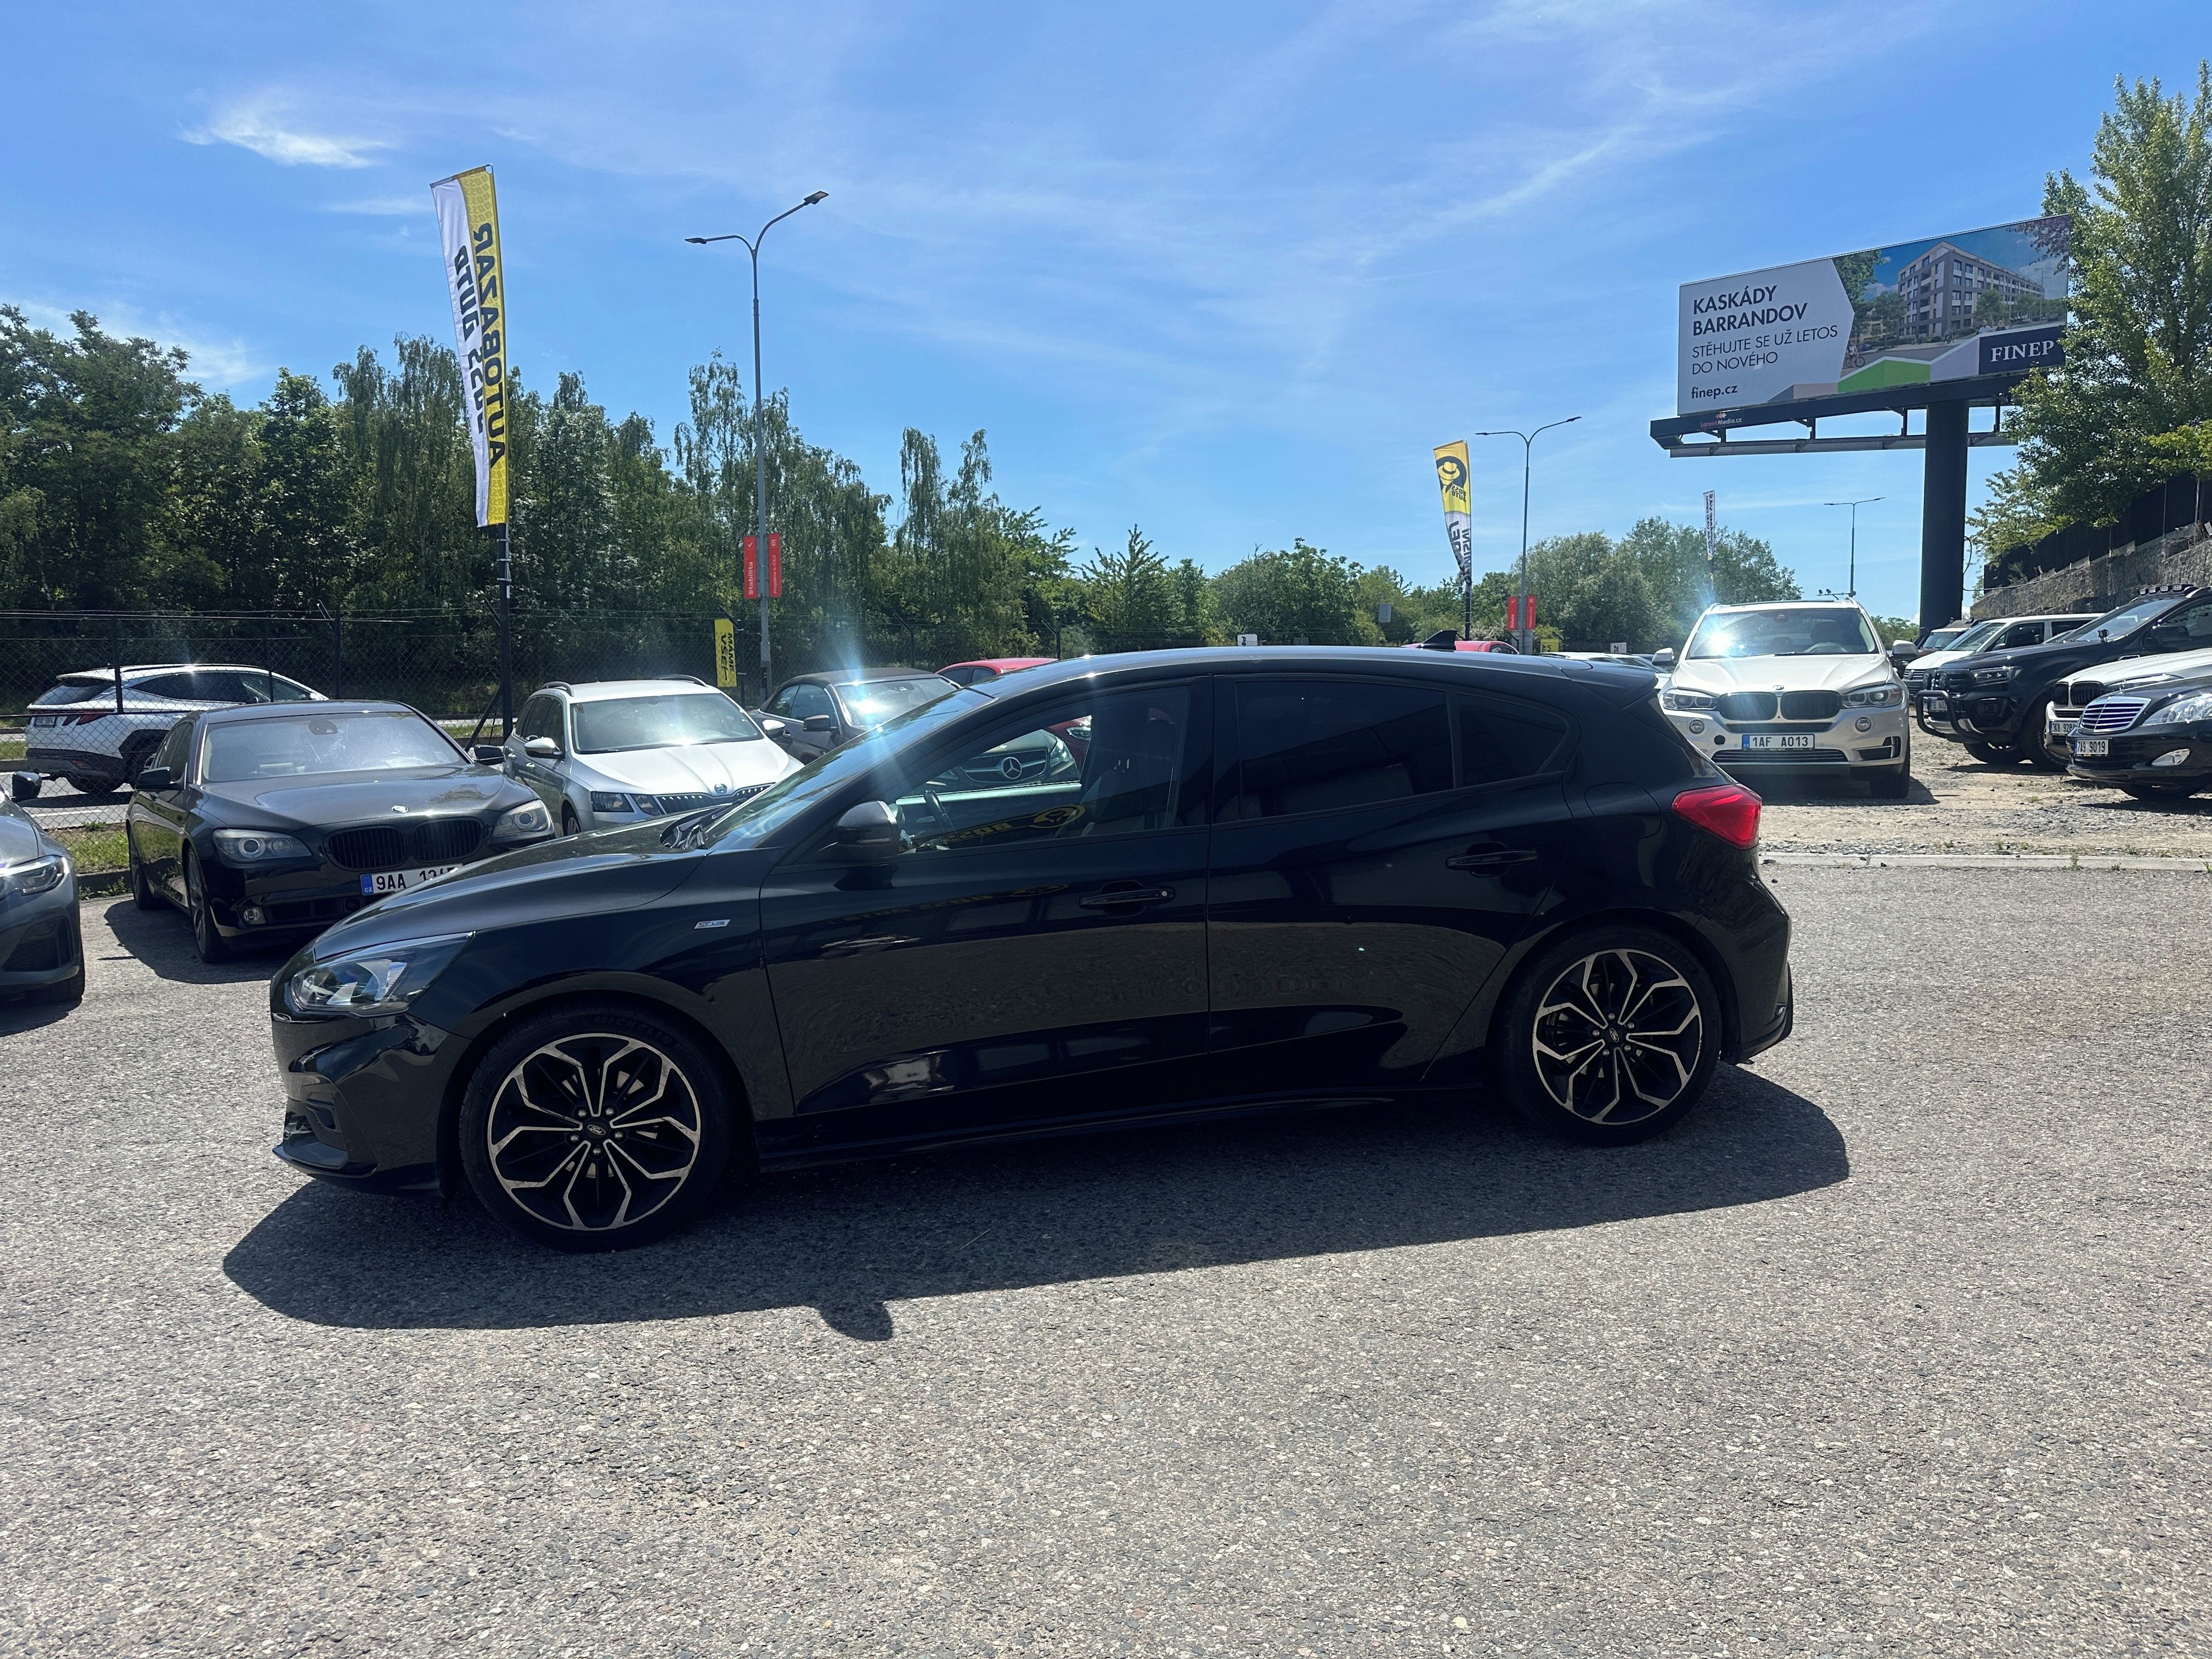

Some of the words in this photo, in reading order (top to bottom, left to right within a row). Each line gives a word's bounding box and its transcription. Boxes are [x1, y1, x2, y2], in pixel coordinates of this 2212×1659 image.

[1693, 285, 1778, 315] KASKÁDY
[1692, 302, 1808, 336] BARRANDOV
[1692, 338, 1751, 358] STĚHUJTE
[1755, 335, 1770, 348] SE
[1774, 329, 1793, 346] UŽ
[1797, 325, 1838, 343] LETOS
[1990, 340, 2055, 362] FINEP
[1692, 361, 1713, 375] DO
[1717, 351, 1778, 371] NOVÉHO
[1691, 385, 1738, 399] finep.cz
[1752, 736, 1772, 747] 1AF
[1781, 736, 1808, 747] A013
[2089, 741, 2106, 752] 9019
[376, 873, 407, 890] 9AA
